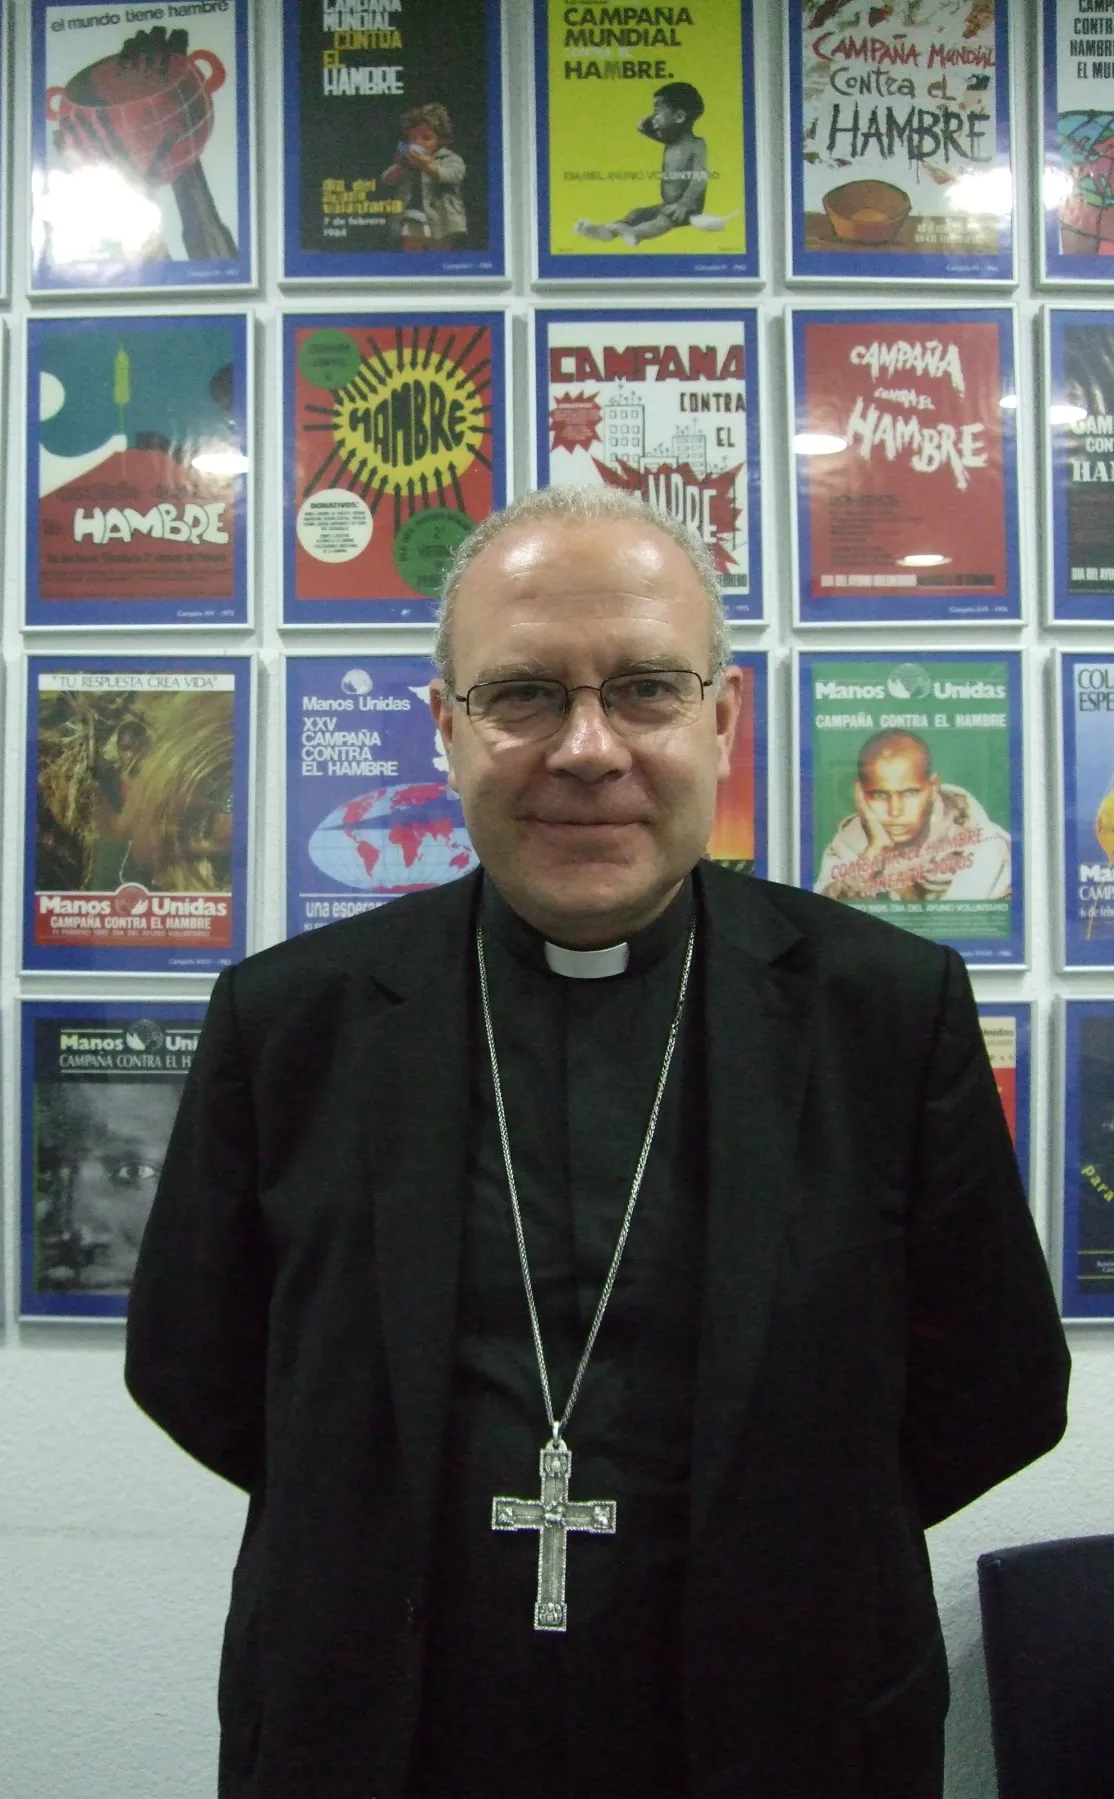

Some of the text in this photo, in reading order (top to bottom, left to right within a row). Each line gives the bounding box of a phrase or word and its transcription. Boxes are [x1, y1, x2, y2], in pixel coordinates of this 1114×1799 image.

[52, 0, 229, 32] el mundo tiene hambre
[334, 30, 402, 49] CONTRA
[564, 28, 682, 47] MUNDIAL
[812, 31, 921, 67] CAMPAÑA
[323, 50, 346, 68] EL
[1077, 62, 1088, 79] EL
[323, 66, 404, 96] HAMBRE
[826, 101, 993, 164] HAMBRE
[850, 339, 966, 399] CAMPAÑA
[680, 392, 746, 413] CONTRA
[349, 379, 467, 468] HAMBRE
[716, 427, 735, 447] EL
[847, 395, 989, 493] HAMBRE
[1086, 437, 1114, 453] CON
[73, 502, 229, 544] HAMBRE
[81, 675, 144, 688] RESPUESTA
[147, 675, 181, 688] CREA
[815, 680, 1006, 700] Manos Unidas
[303, 697, 411, 711] Manos Unidas
[303, 717, 337, 731] XXV
[815, 711, 1007, 728] CAMPAÑA CONTRA EL HAMBRE
[302, 730, 381, 746] CAMPAÑA
[302, 747, 372, 761] CONTRA
[302, 762, 399, 776] EL HAMBRE
[39, 896, 227, 917] Manos Unidas
[306, 902, 329, 917] una
[50, 913, 212, 930] CAMPAÑA CONTRA EL HAMBRE
[60, 1034, 124, 1051] Manos
[60, 1052, 113, 1068] CAMPAÑA
[117, 1055, 162, 1068] CONTRA
[166, 1055, 178, 1068] EL
[1081, 1164, 1114, 1203] Para
